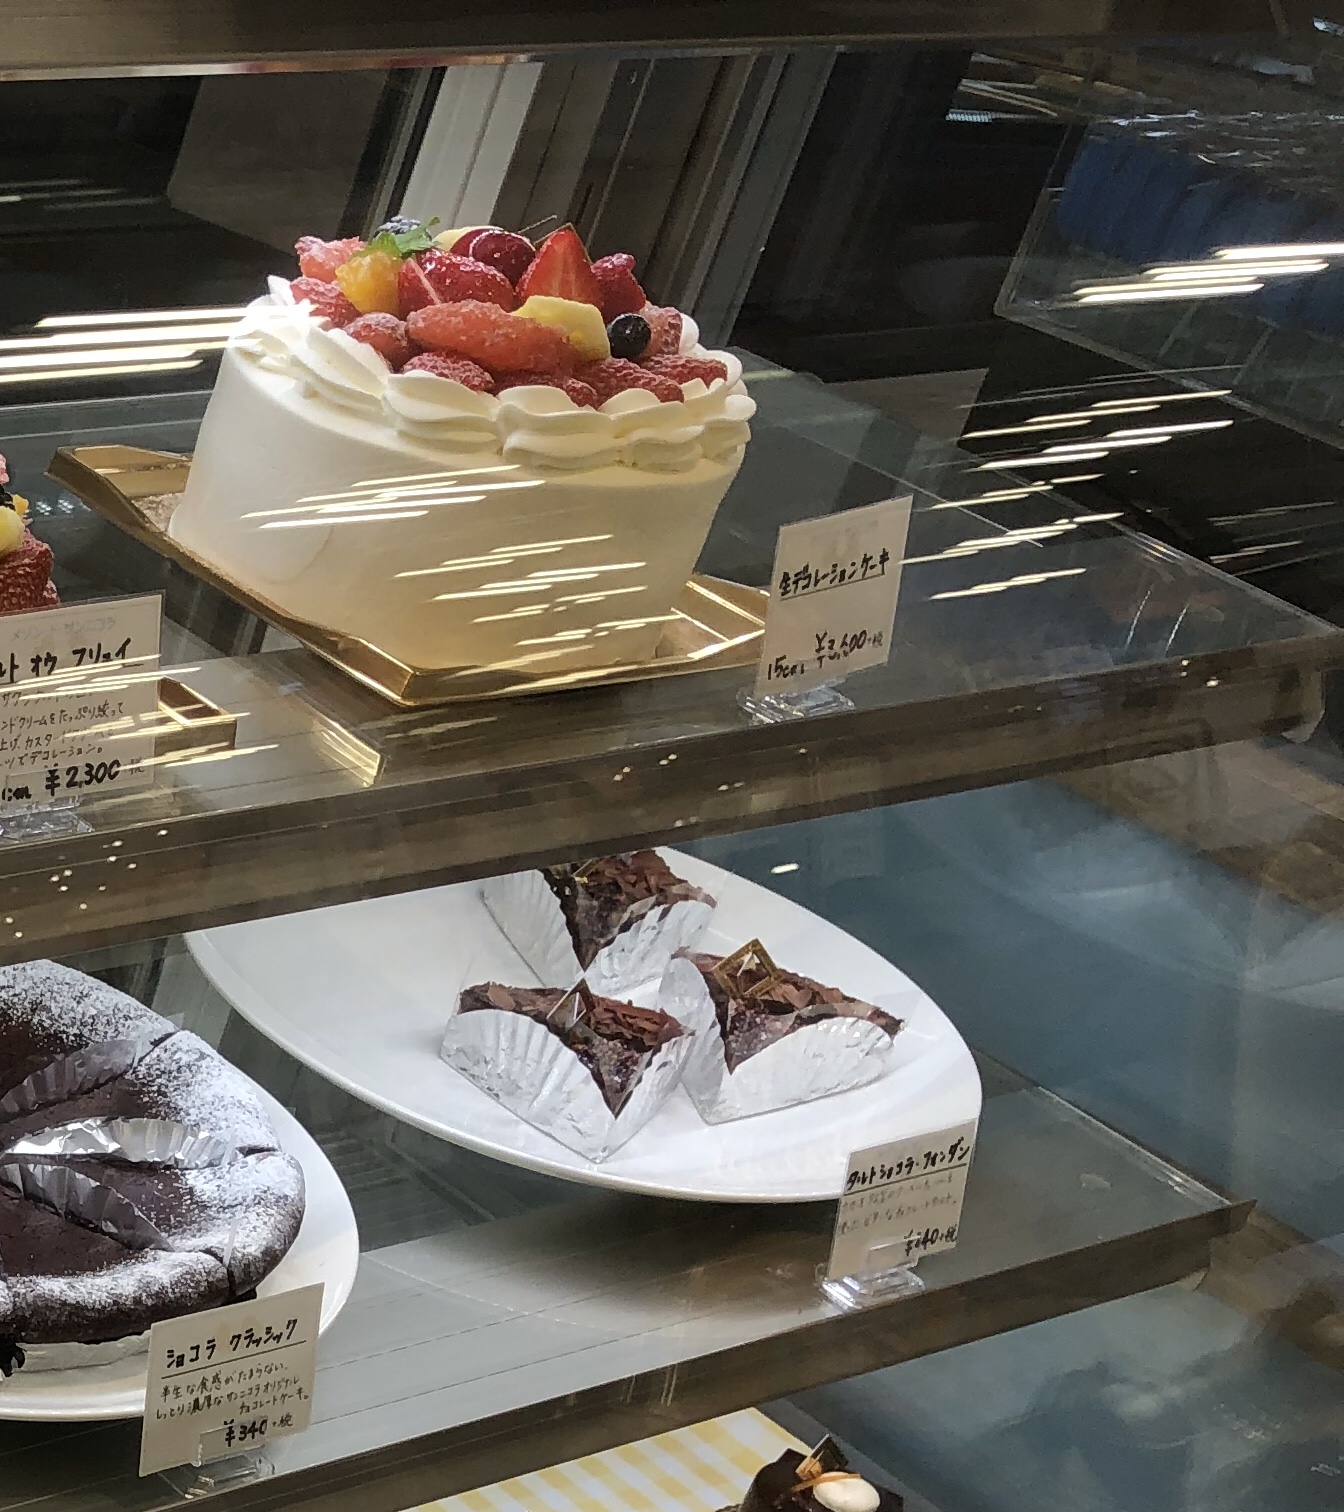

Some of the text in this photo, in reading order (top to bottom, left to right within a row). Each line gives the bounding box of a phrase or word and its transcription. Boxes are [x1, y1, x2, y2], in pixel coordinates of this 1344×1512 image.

[777, 542, 891, 598] 生デコレーションケーキ
[29, 650, 57, 678] オウ
[164, 1315, 298, 1371] ショコラ クラッシック
[220, 1407, 269, 1449] ¥340
